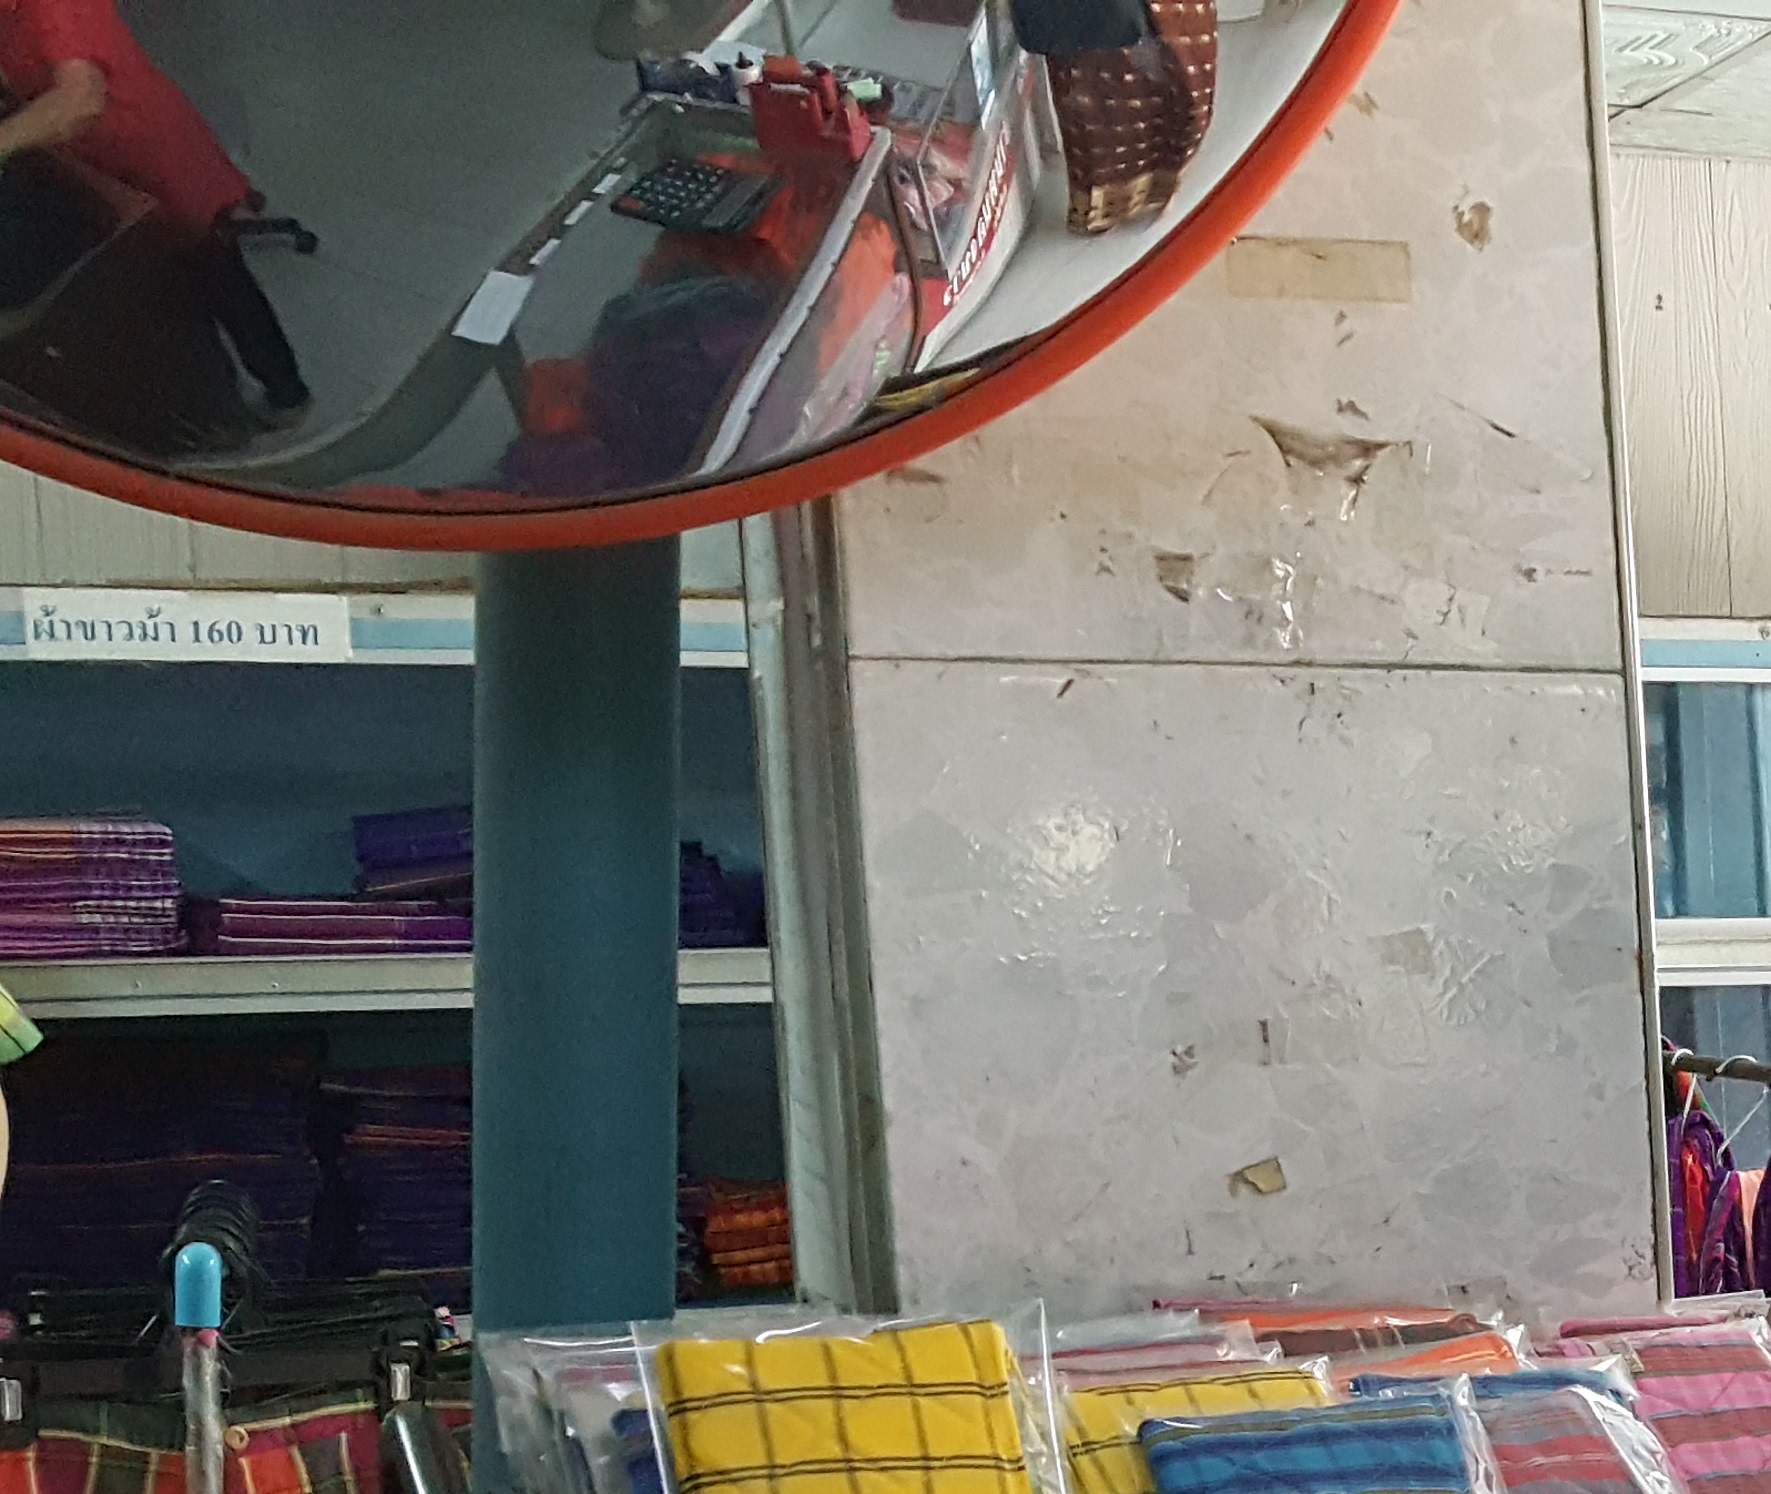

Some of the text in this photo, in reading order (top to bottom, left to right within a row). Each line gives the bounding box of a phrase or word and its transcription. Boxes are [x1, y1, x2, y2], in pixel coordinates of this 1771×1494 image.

[33, 604, 319, 646] ผ้าขาวม้า 160 บาท
